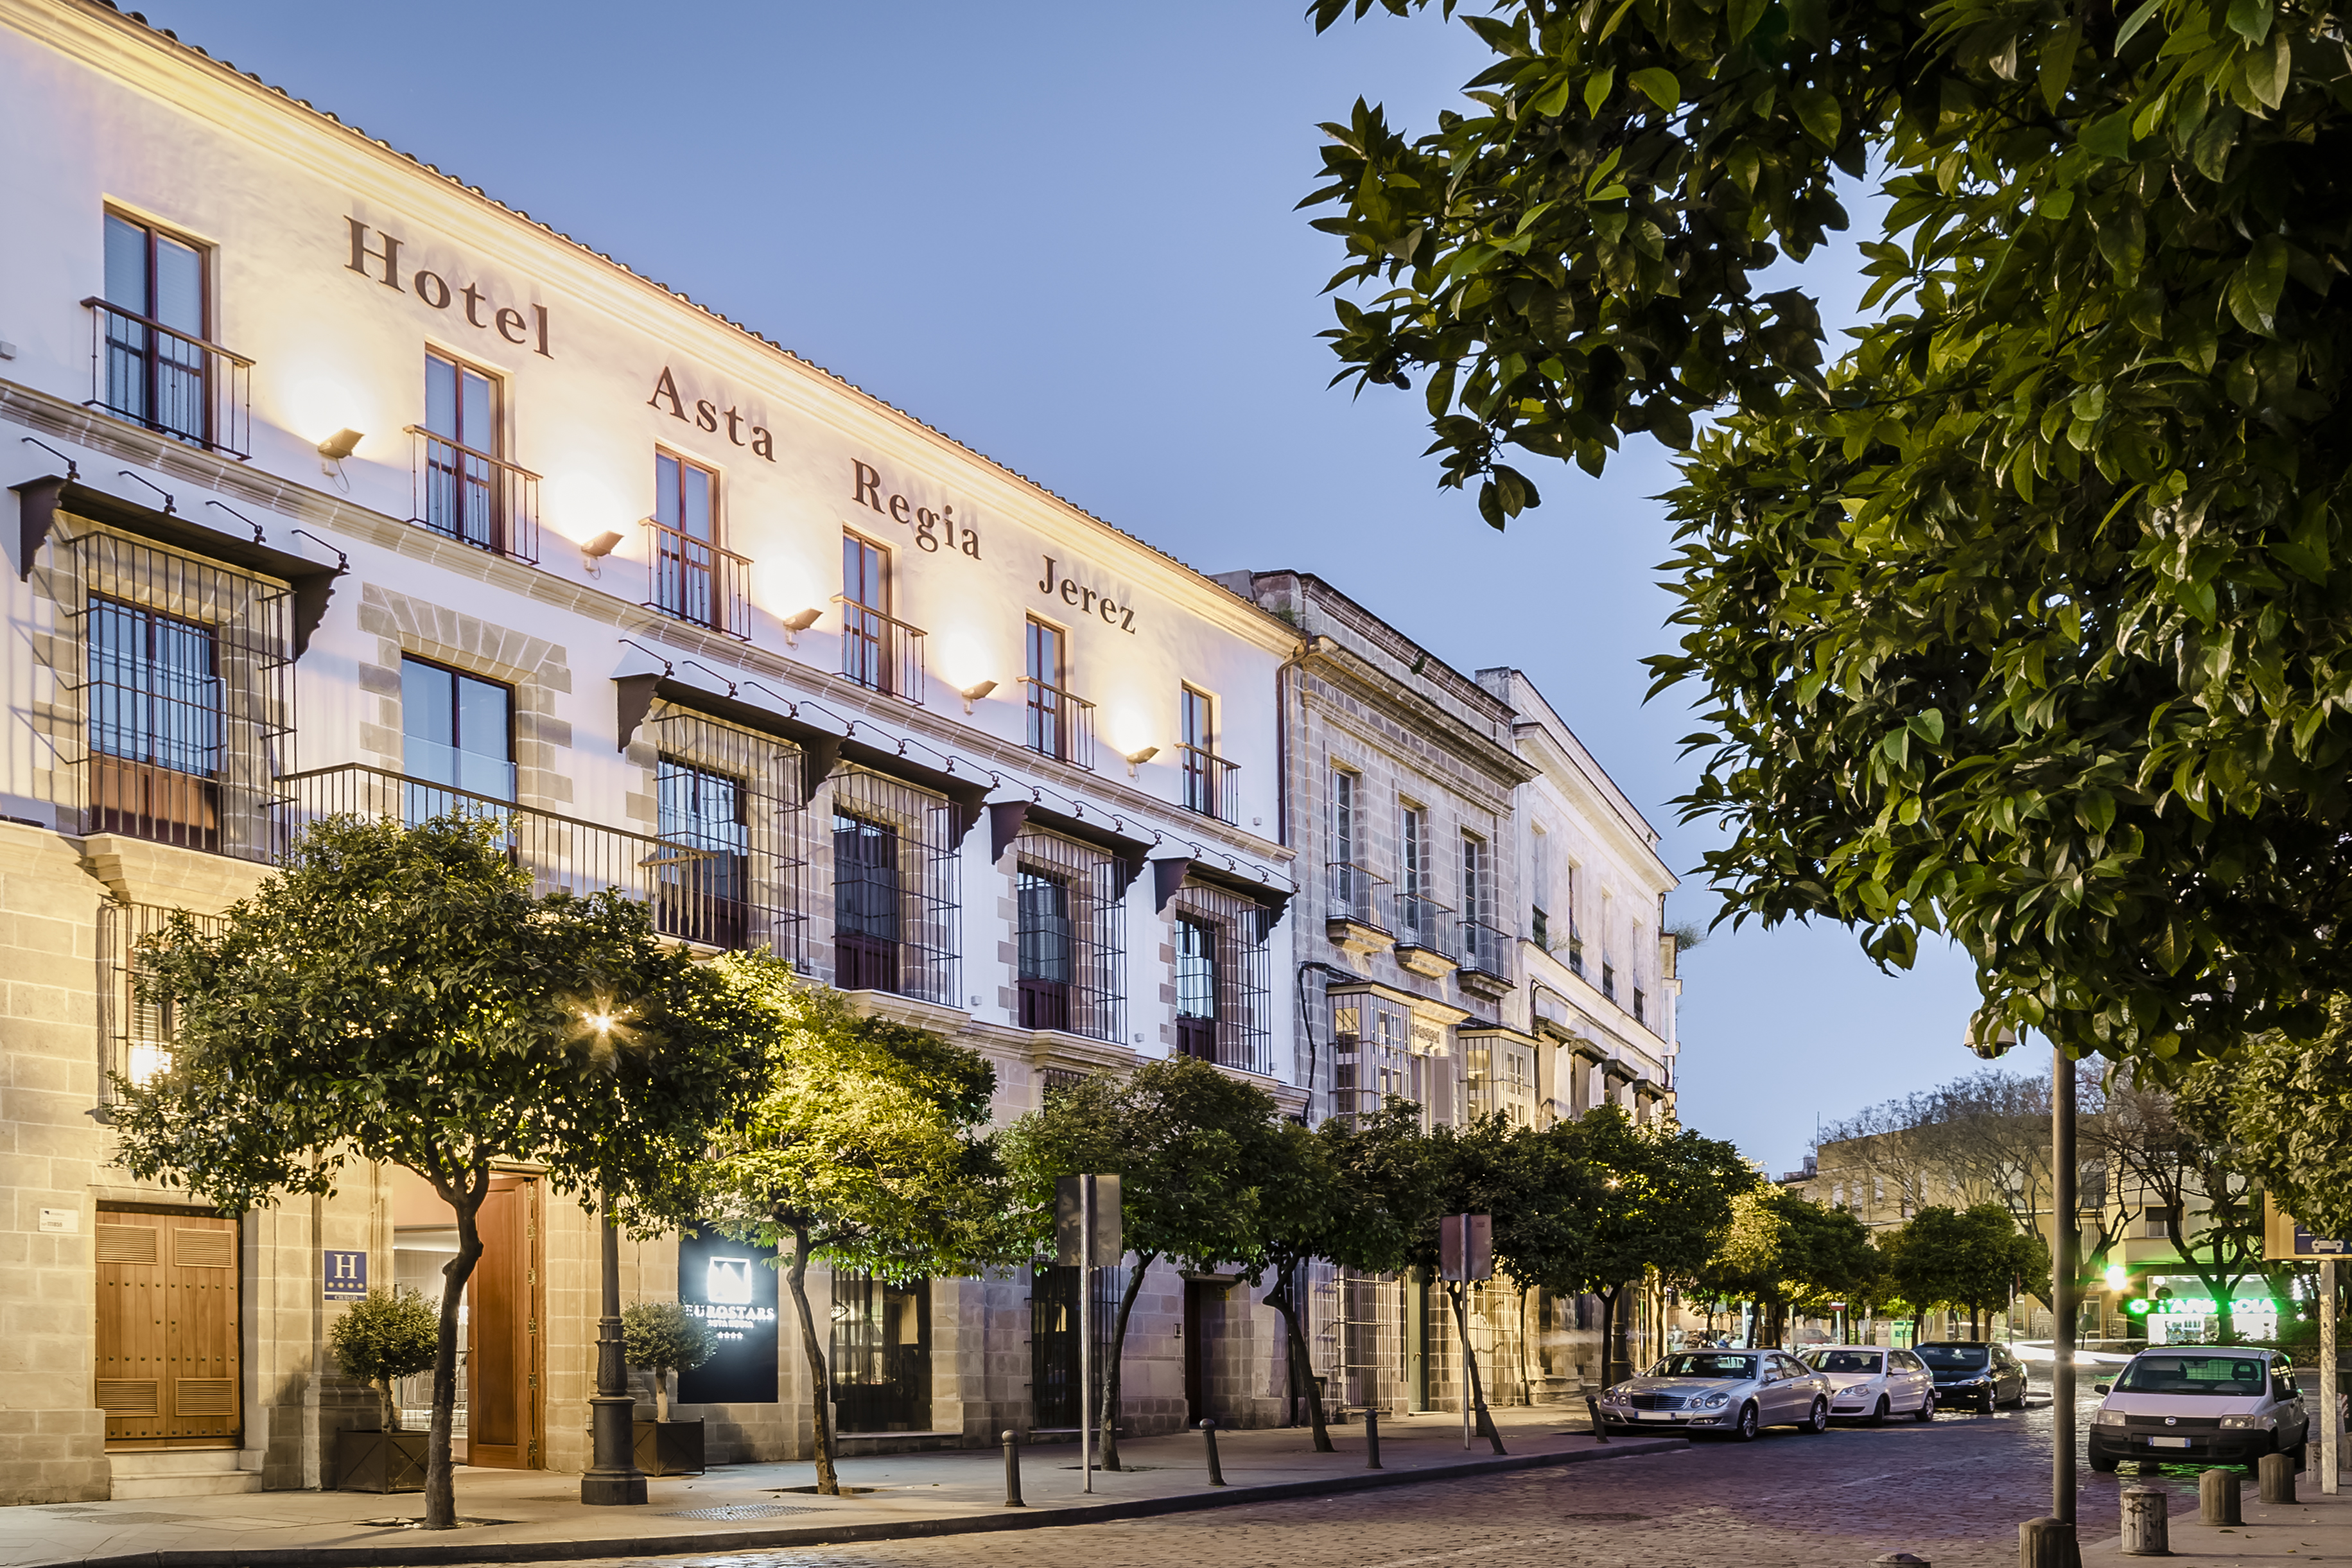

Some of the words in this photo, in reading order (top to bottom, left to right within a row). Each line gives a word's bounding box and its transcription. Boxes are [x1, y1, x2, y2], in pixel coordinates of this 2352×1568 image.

[343, 214, 554, 360] Hotel
[647, 365, 776, 462] Asta
[851, 457, 982, 560] Regia
[1038, 554, 1136, 634] Jerez
[334, 1254, 357, 1278] H
[684, 1304, 775, 1320] EUROSTARS
[2158, 1299, 2277, 1314] FARMCIA
